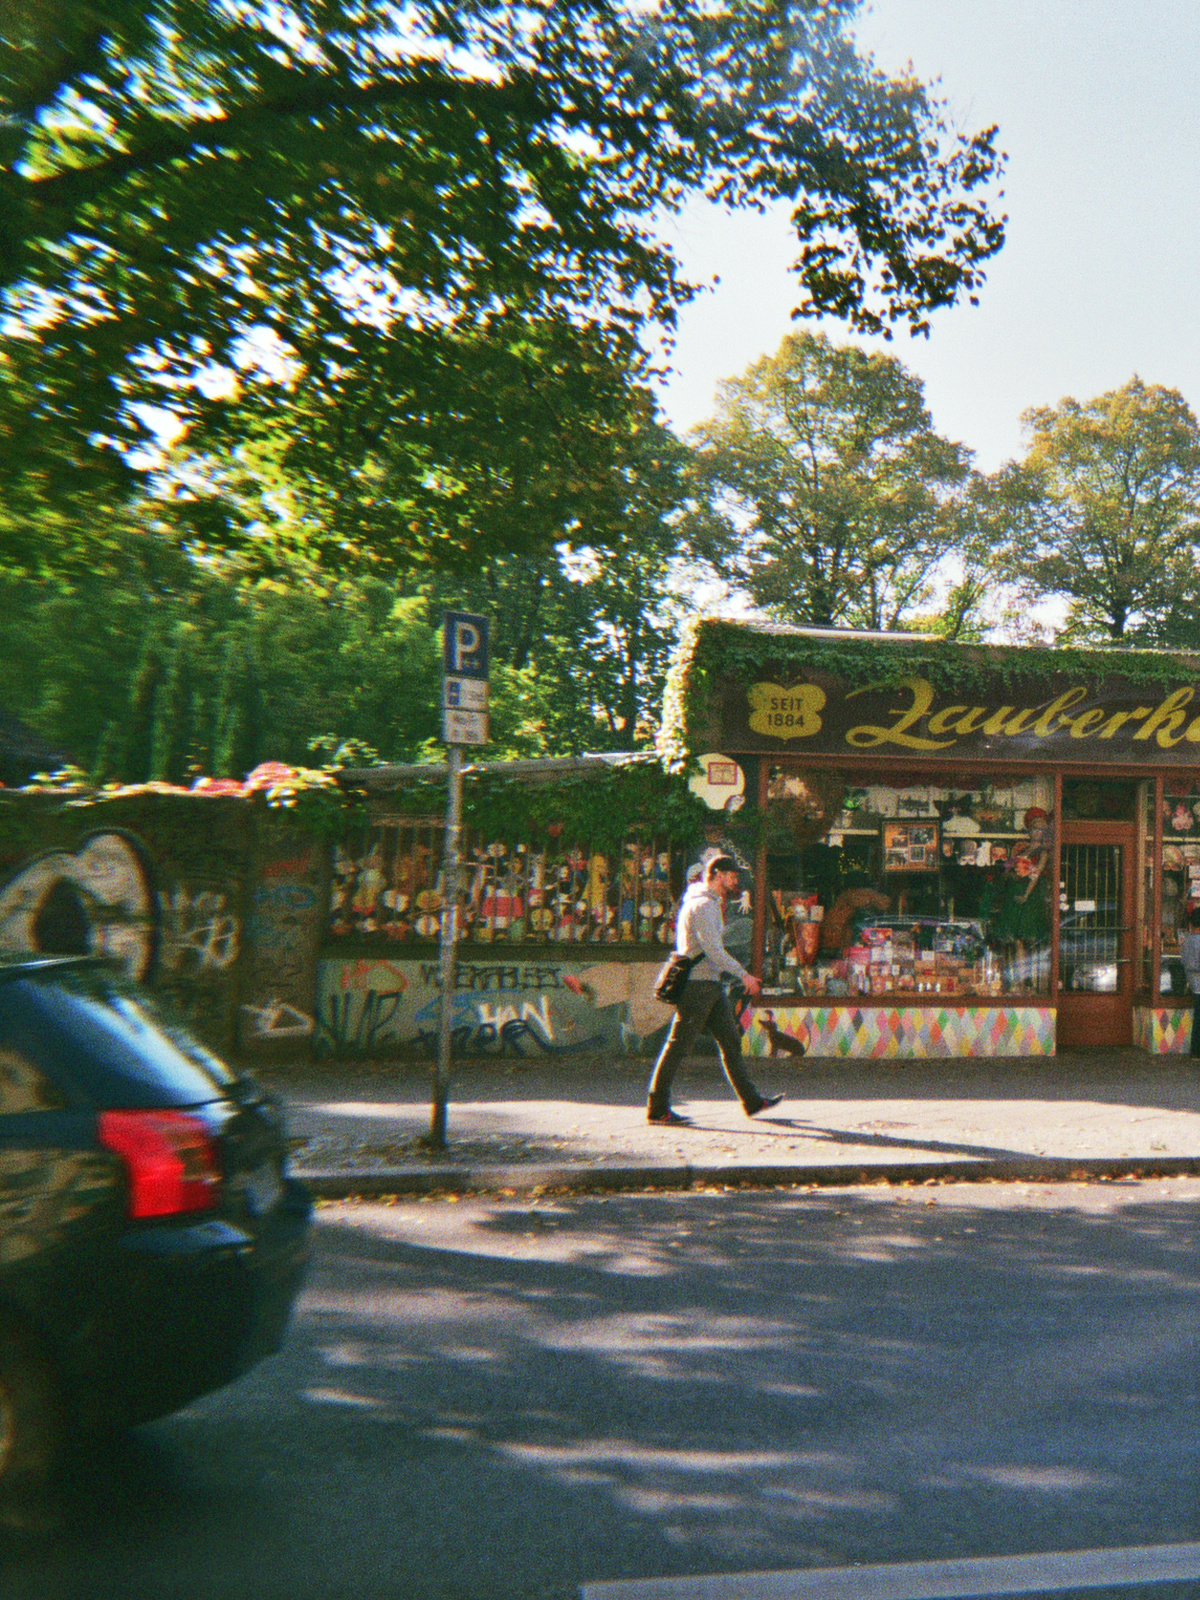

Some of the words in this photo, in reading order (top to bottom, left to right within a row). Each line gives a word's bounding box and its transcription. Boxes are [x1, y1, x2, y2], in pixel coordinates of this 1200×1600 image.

[456, 622, 480, 670] P
[770, 697, 804, 709] SEIT
[767, 713, 806, 728] 1884
